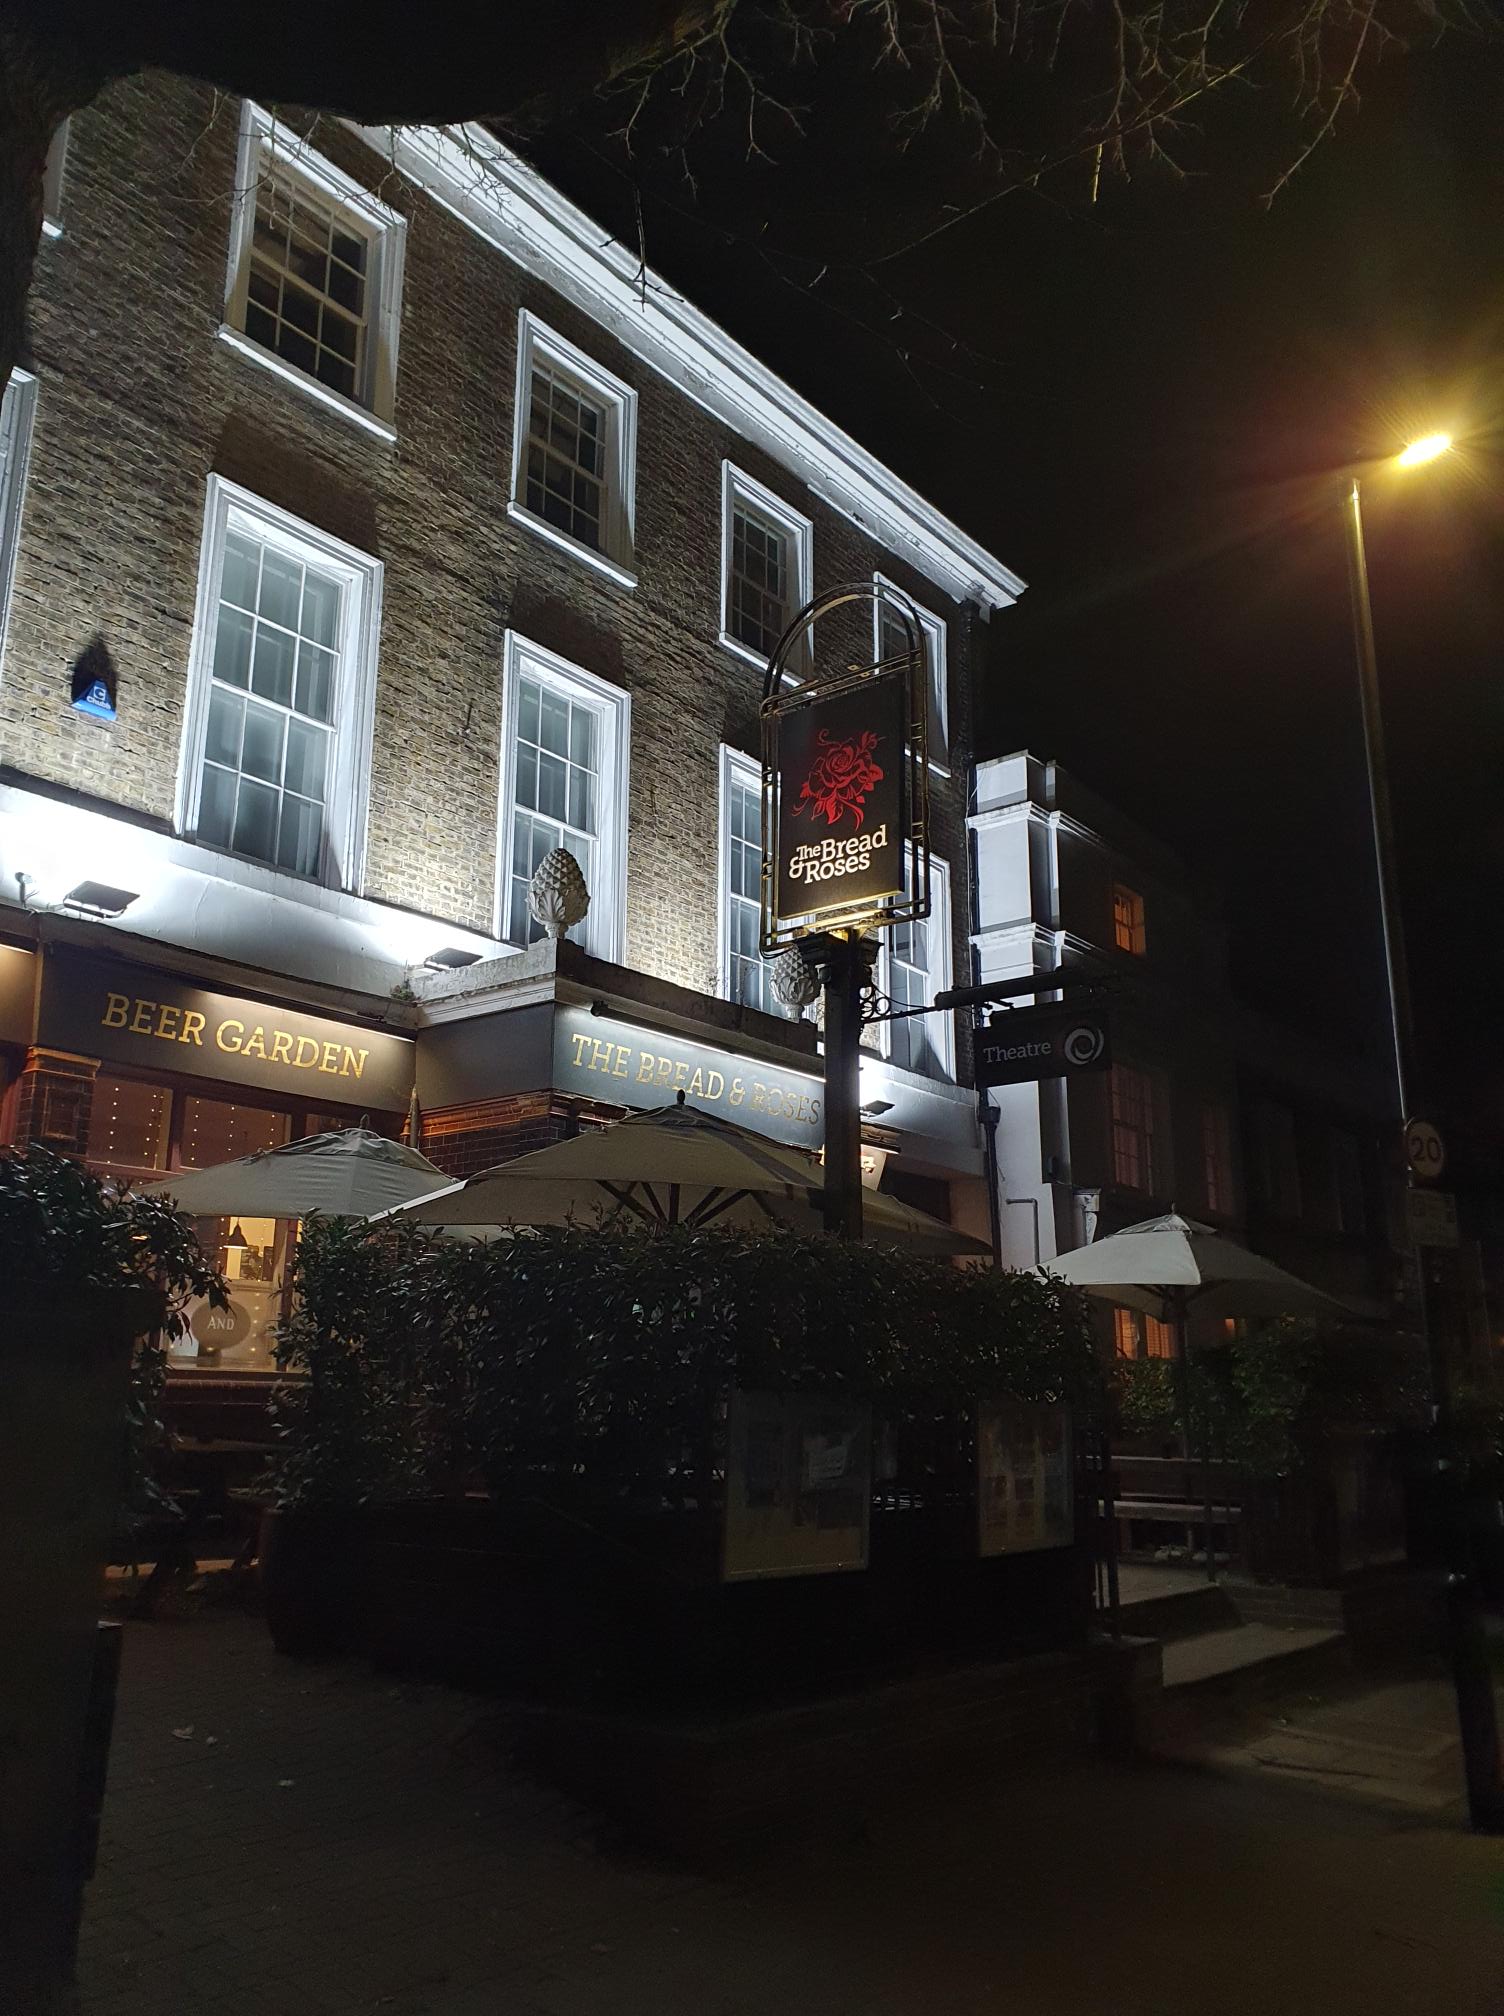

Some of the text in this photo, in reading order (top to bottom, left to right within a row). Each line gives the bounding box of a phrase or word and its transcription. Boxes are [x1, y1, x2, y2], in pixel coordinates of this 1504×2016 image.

[796, 824, 888, 862] The Bread
[789, 853, 870, 884] & Roses
[102, 992, 369, 1079] BEER GARDEN
[983, 1041, 1051, 1064] Theatre
[572, 1034, 821, 1126] THE BREAD & ROSES
[1411, 1137, 1441, 1162] 20
[207, 1316, 235, 1331] AND
